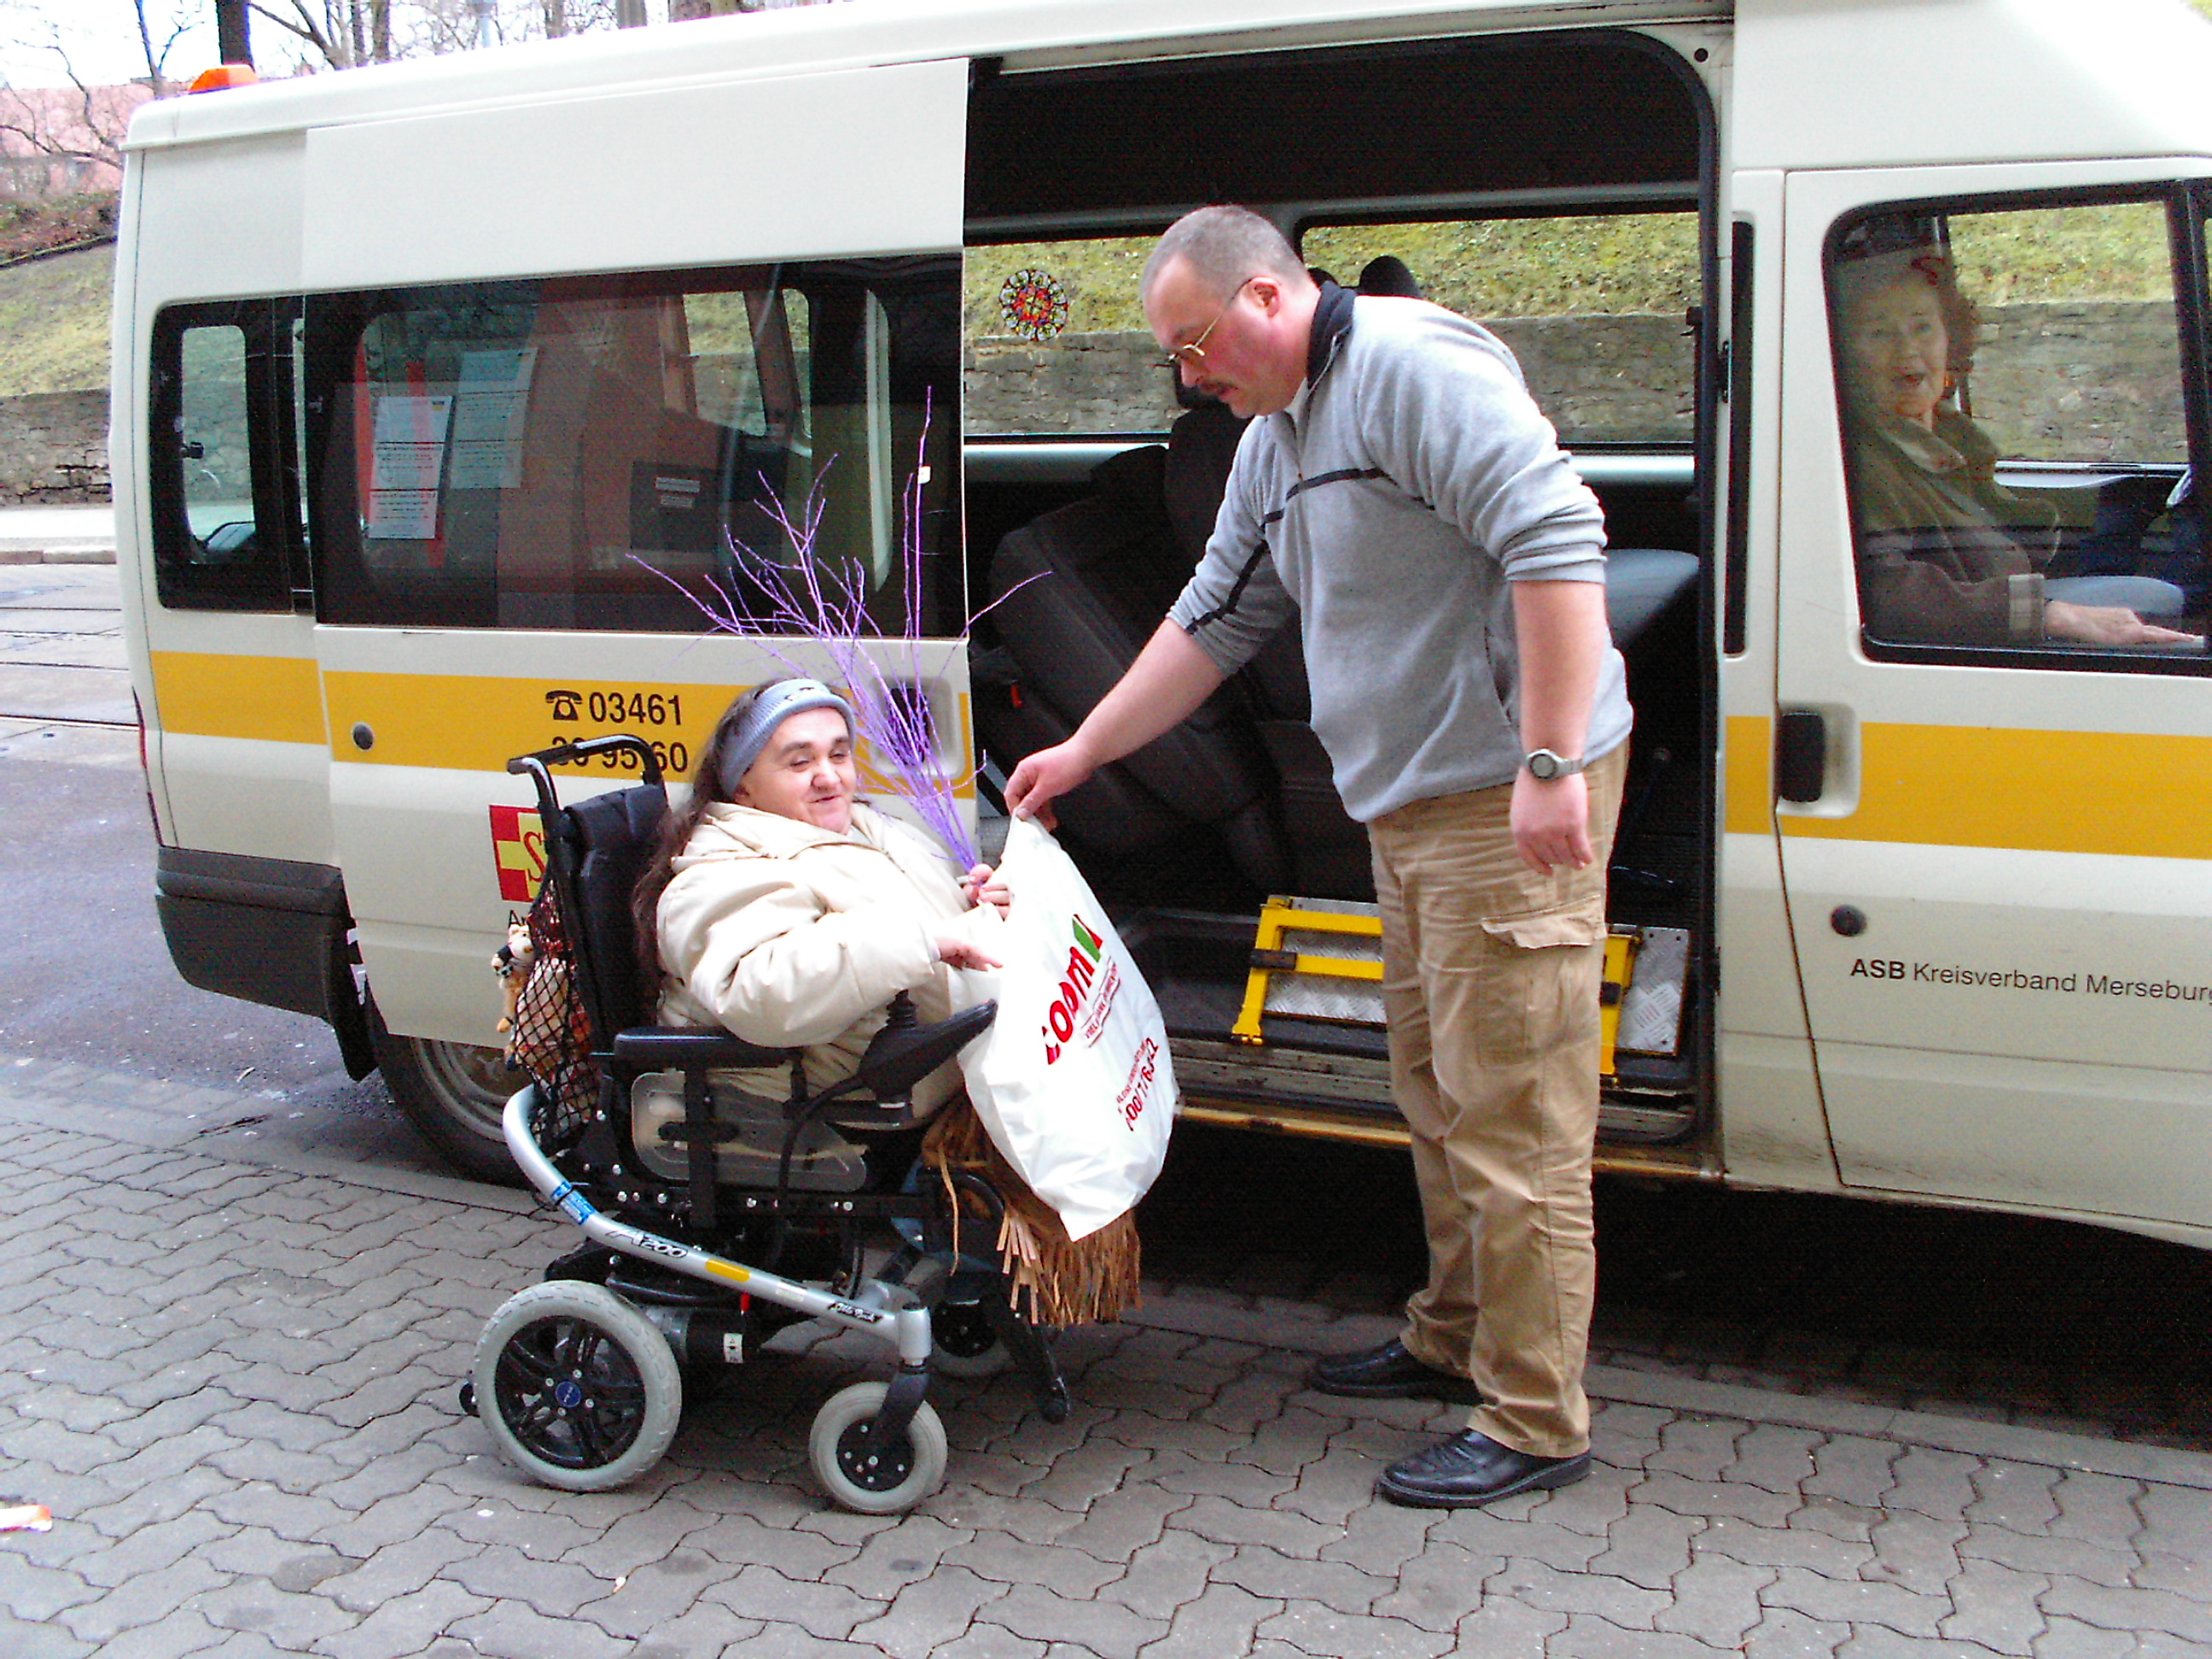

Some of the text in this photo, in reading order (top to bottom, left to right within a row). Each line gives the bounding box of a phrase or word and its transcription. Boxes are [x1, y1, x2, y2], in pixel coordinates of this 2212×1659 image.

[589, 691, 683, 725] 03461
[1850, 958, 2212, 1005] ASB Kreisverband Mersebur
